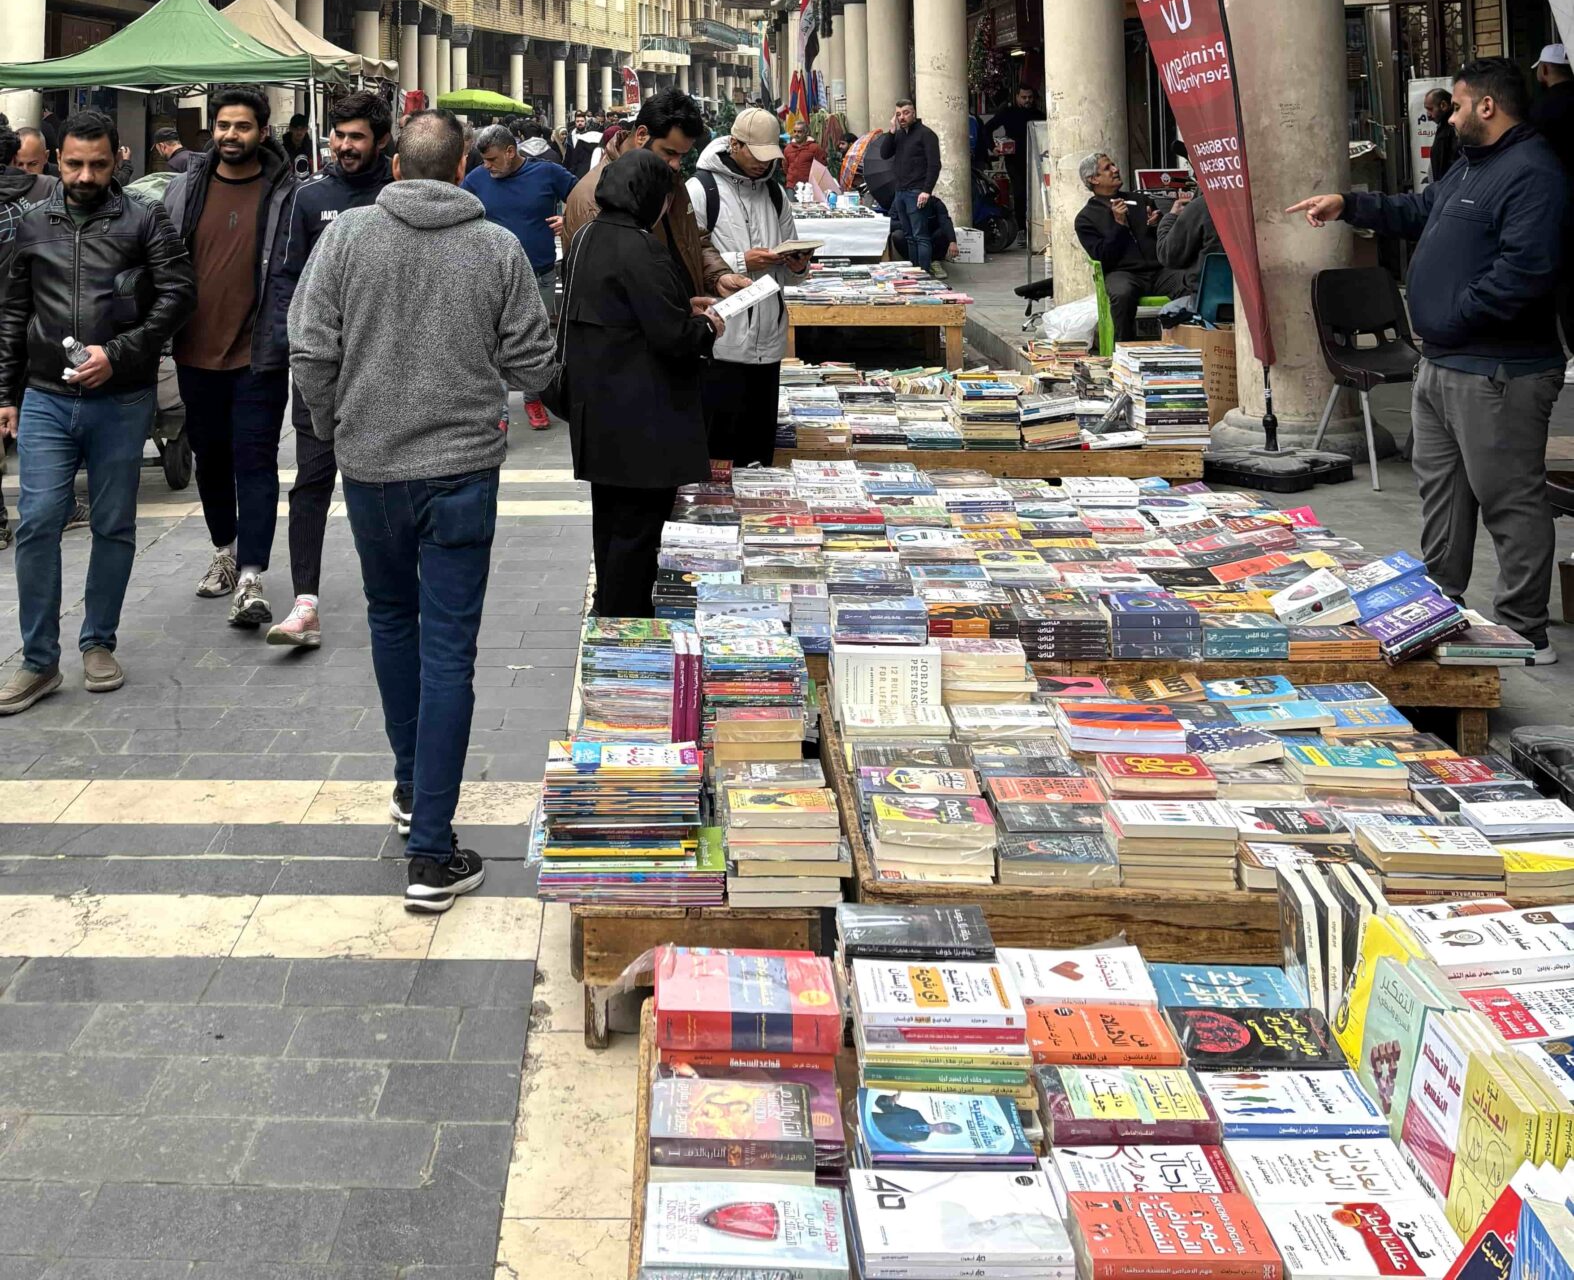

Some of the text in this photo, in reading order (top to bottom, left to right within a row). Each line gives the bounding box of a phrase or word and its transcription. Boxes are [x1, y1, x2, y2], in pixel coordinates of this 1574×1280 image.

[321, 210, 338, 221] JAKO
[879, 666, 887, 706] FOR LIFE
[890, 666, 899, 705] 12 RULES
[910, 659, 919, 706] PETERSO
[920, 658, 929, 704] JORDAN
[1129, 680, 1160, 700] WORK
[1163, 675, 1193, 694] DEEP
[945, 800, 962, 819] Chess
[1396, 831, 1417, 845] BILL
[1439, 829, 1474, 851] BODY
[1460, 831, 1491, 849] THE
[1509, 937, 1531, 951] علم
[911, 969, 940, 988] شيء
[1512, 967, 1522, 976] 50
[888, 969, 912, 1003] لأي إنسان
[917, 990, 949, 1003] أي
[942, 969, 970, 1003] كيف تبيع
[1380, 975, 1414, 1016] التفكير
[1513, 992, 1534, 1011] THINK
[1533, 991, 1565, 1016] CHANGE
[1099, 1013, 1131, 1047] اللامبالاة
[1243, 1020, 1277, 1046] النفسي
[1263, 1017, 1288, 1039] الصراع
[1549, 1016, 1566, 1031] YOU
[1048, 1033, 1061, 1046] مارك
[1131, 1035, 1152, 1047] فن
[1279, 1041, 1294, 1051] من
[1292, 1034, 1322, 1056] قوانين
[730, 1057, 780, 1069] قواعد السطوة
[1423, 1042, 1461, 1097] علم التحكم
[1085, 1074, 1108, 1112] جولمان
[1104, 1078, 1124, 1107] دانيال
[1139, 1075, 1170, 1114] العاطفي
[1163, 1075, 1189, 1113] الذكاء
[1423, 1080, 1448, 1117] النفسي
[1150, 1152, 1200, 1193] لرجال
[1260, 1168, 1275, 1185] جيمس
[1306, 1149, 1357, 1190] الذرية
[1339, 1144, 1393, 1196] العادات
[866, 1175, 914, 1211] 40
[677, 1200, 688, 1215] THE
[805, 1212, 818, 1237] فارس
[1136, 1202, 1178, 1254] النفسية
[1157, 1200, 1204, 1254] الأمراض
[1193, 1219, 1232, 1254] فهم
[1209, 1195, 1248, 1255] PSYCHO-LOGICAL
[1356, 1208, 1409, 1271] عقلك الباطن
[1396, 1221, 1436, 1260] قوة
